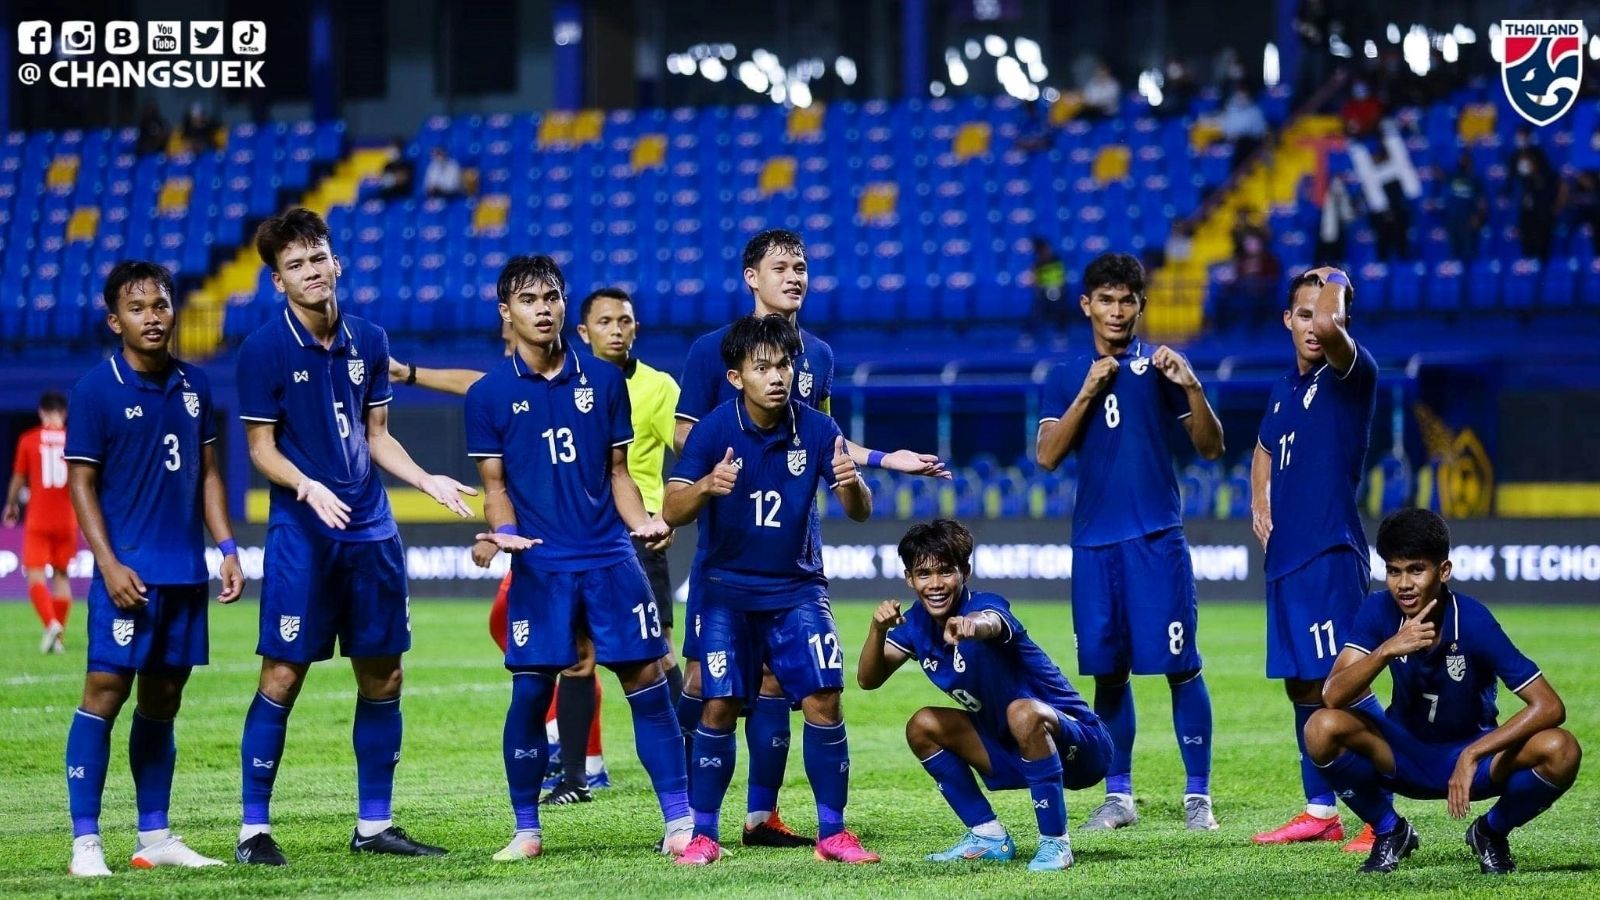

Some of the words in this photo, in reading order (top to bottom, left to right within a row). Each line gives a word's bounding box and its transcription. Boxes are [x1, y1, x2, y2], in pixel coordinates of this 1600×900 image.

[332, 401, 350, 439] 5
[1104, 393, 1120, 429] 8
[163, 433, 181, 472] 3
[541, 427, 577, 465] 13
[1279, 431, 1295, 471] 11
[749, 490, 782, 528] 12
[632, 602, 662, 640] 13
[1168, 621, 1184, 655] 8
[1309, 619, 1338, 659] 11
[808, 632, 843, 670] 12
[1422, 692, 1439, 723] 7
